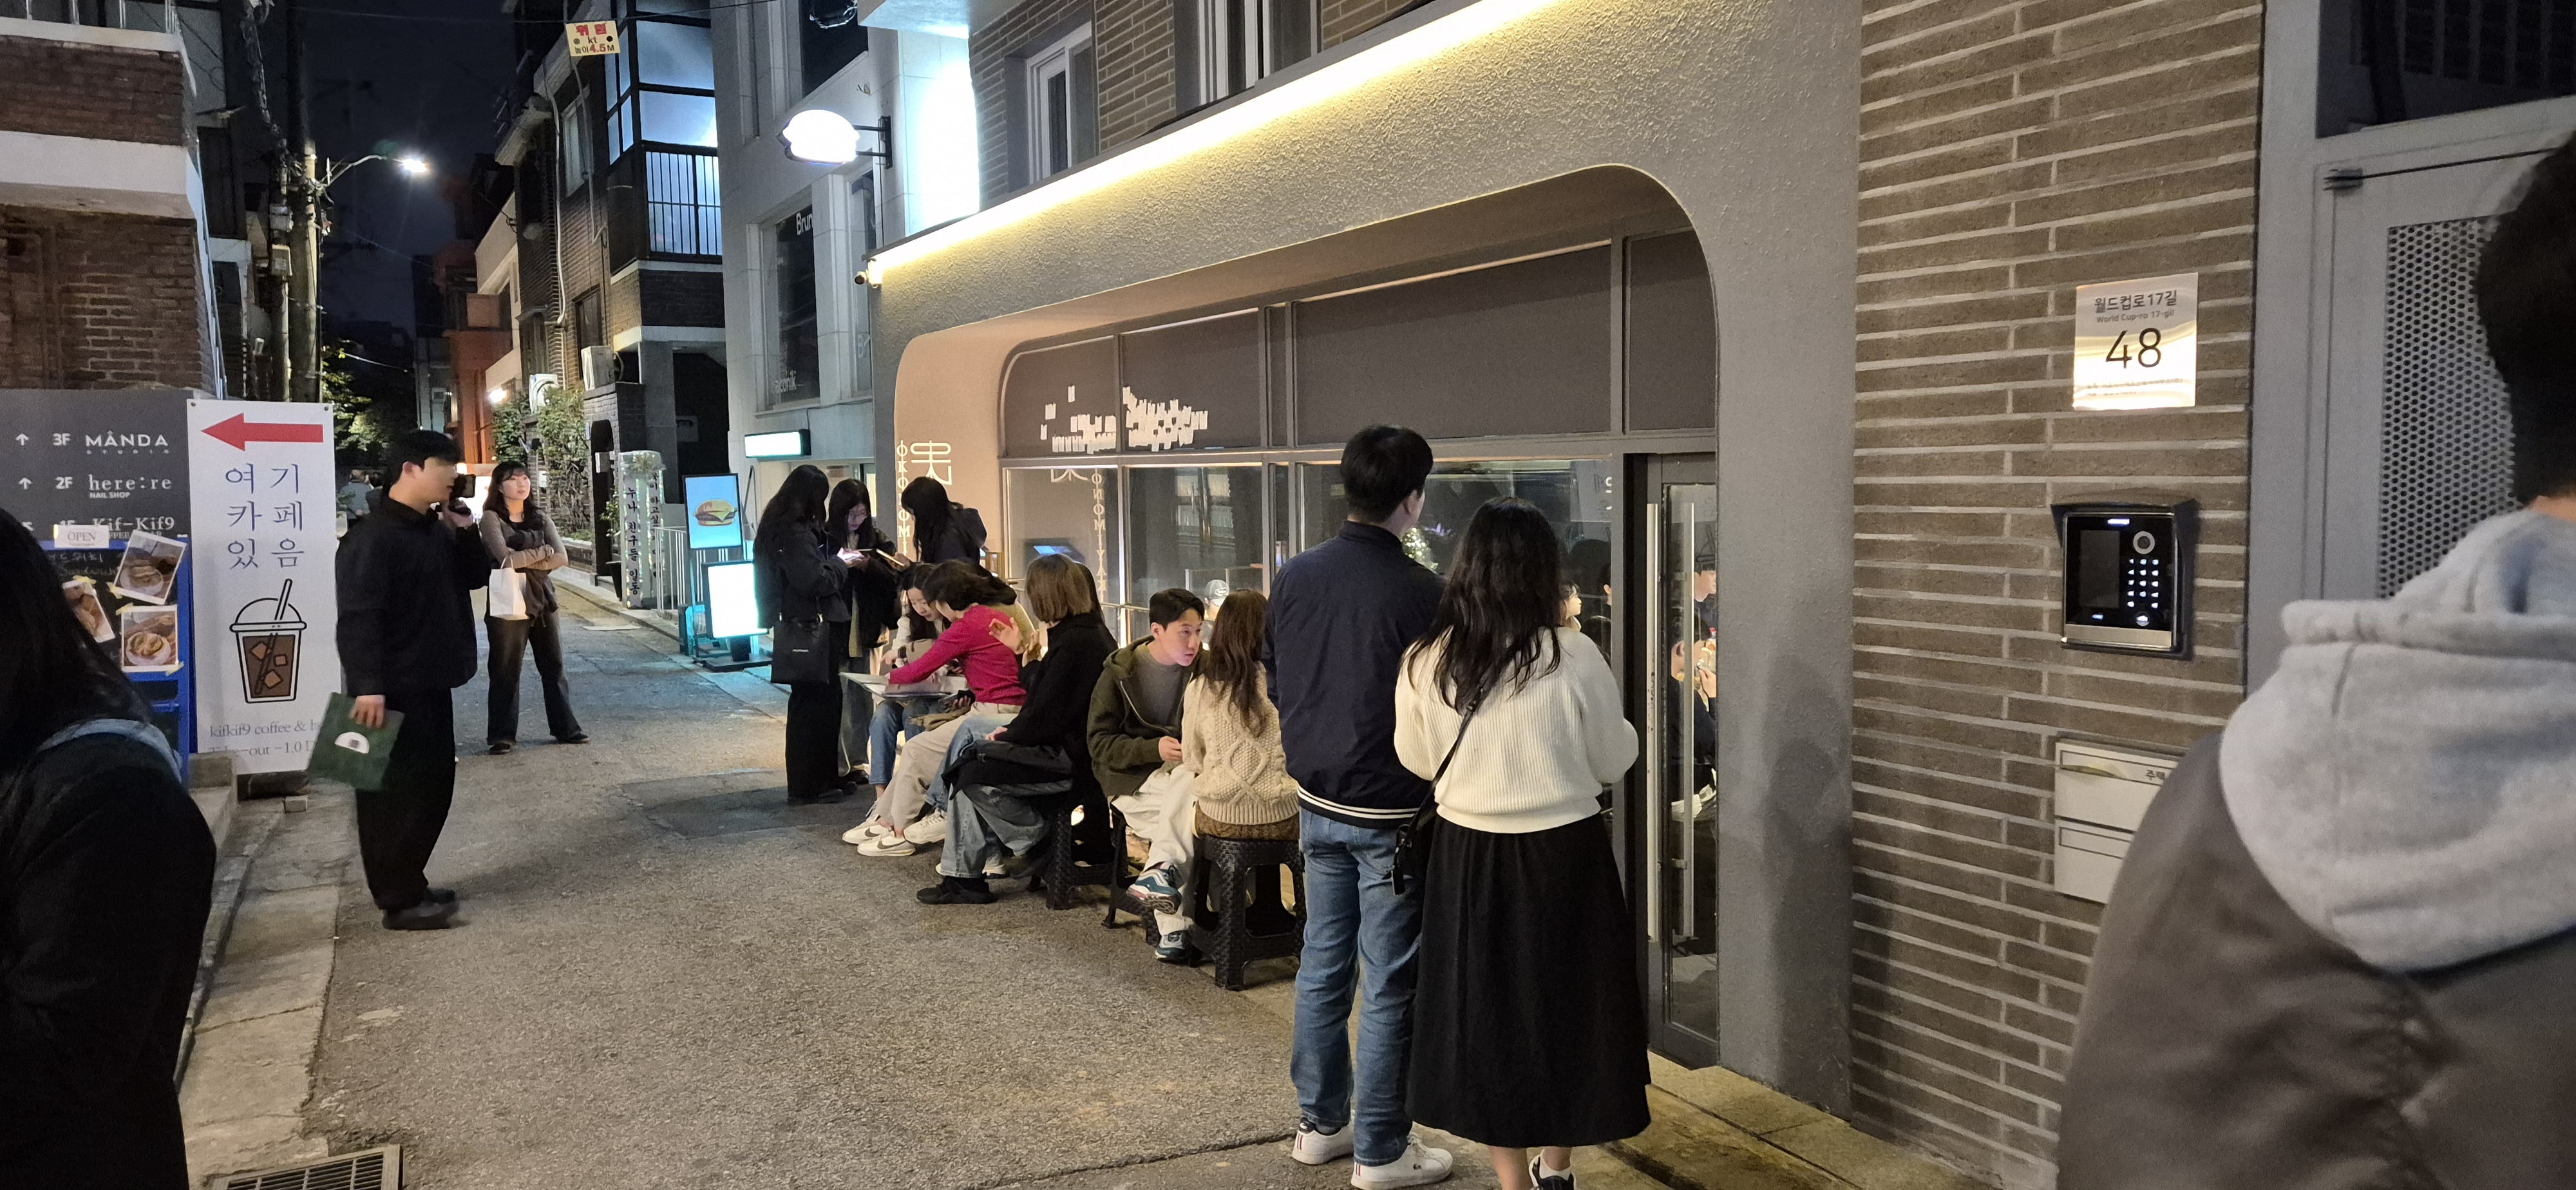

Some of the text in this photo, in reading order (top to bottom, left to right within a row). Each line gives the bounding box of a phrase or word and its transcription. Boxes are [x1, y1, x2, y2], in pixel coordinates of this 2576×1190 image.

[2094, 290, 2177, 314] 월드컵로17길
[2096, 309, 2175, 323] World Cup-ro 17-gil
[2105, 327, 2161, 369] 48
[53, 433, 71, 446] 3F
[55, 476, 73, 490] 2F
[67, 531, 96, 542] OPEN
[626, 487, 640, 596] 누나 친구들 일동
[254, 721, 290, 735] coffee
[294, 720, 306, 732] &
